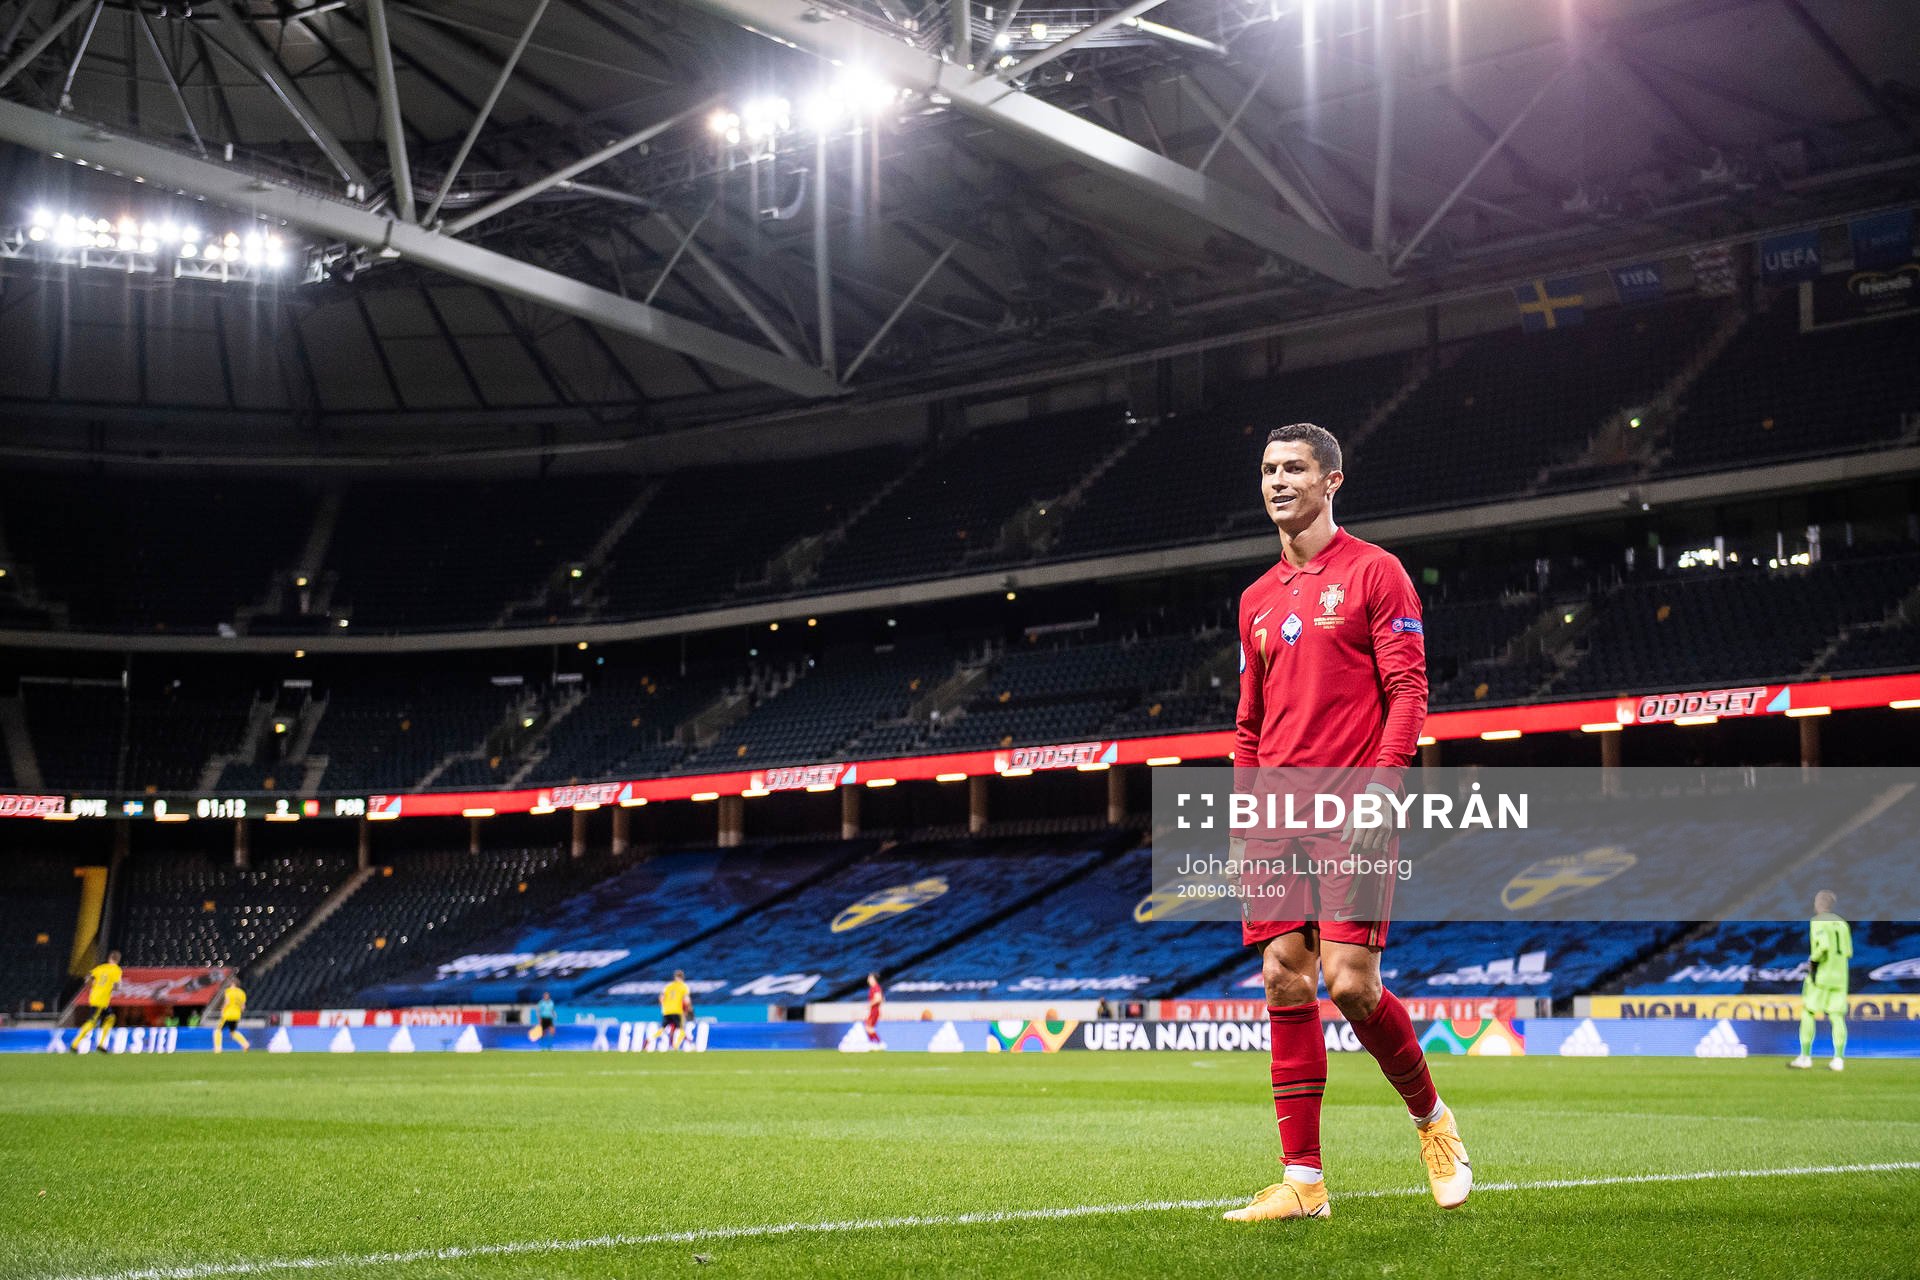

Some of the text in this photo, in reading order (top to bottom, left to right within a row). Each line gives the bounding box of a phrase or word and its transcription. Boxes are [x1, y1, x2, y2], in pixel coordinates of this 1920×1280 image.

[1764, 248, 1819, 271] UEFA
[1637, 687, 1768, 723] ODDSET
[1010, 742, 1102, 770] ODDSET
[764, 763, 844, 790] ODDSET
[1083, 1021, 1272, 1051] UEFA NATIONS
